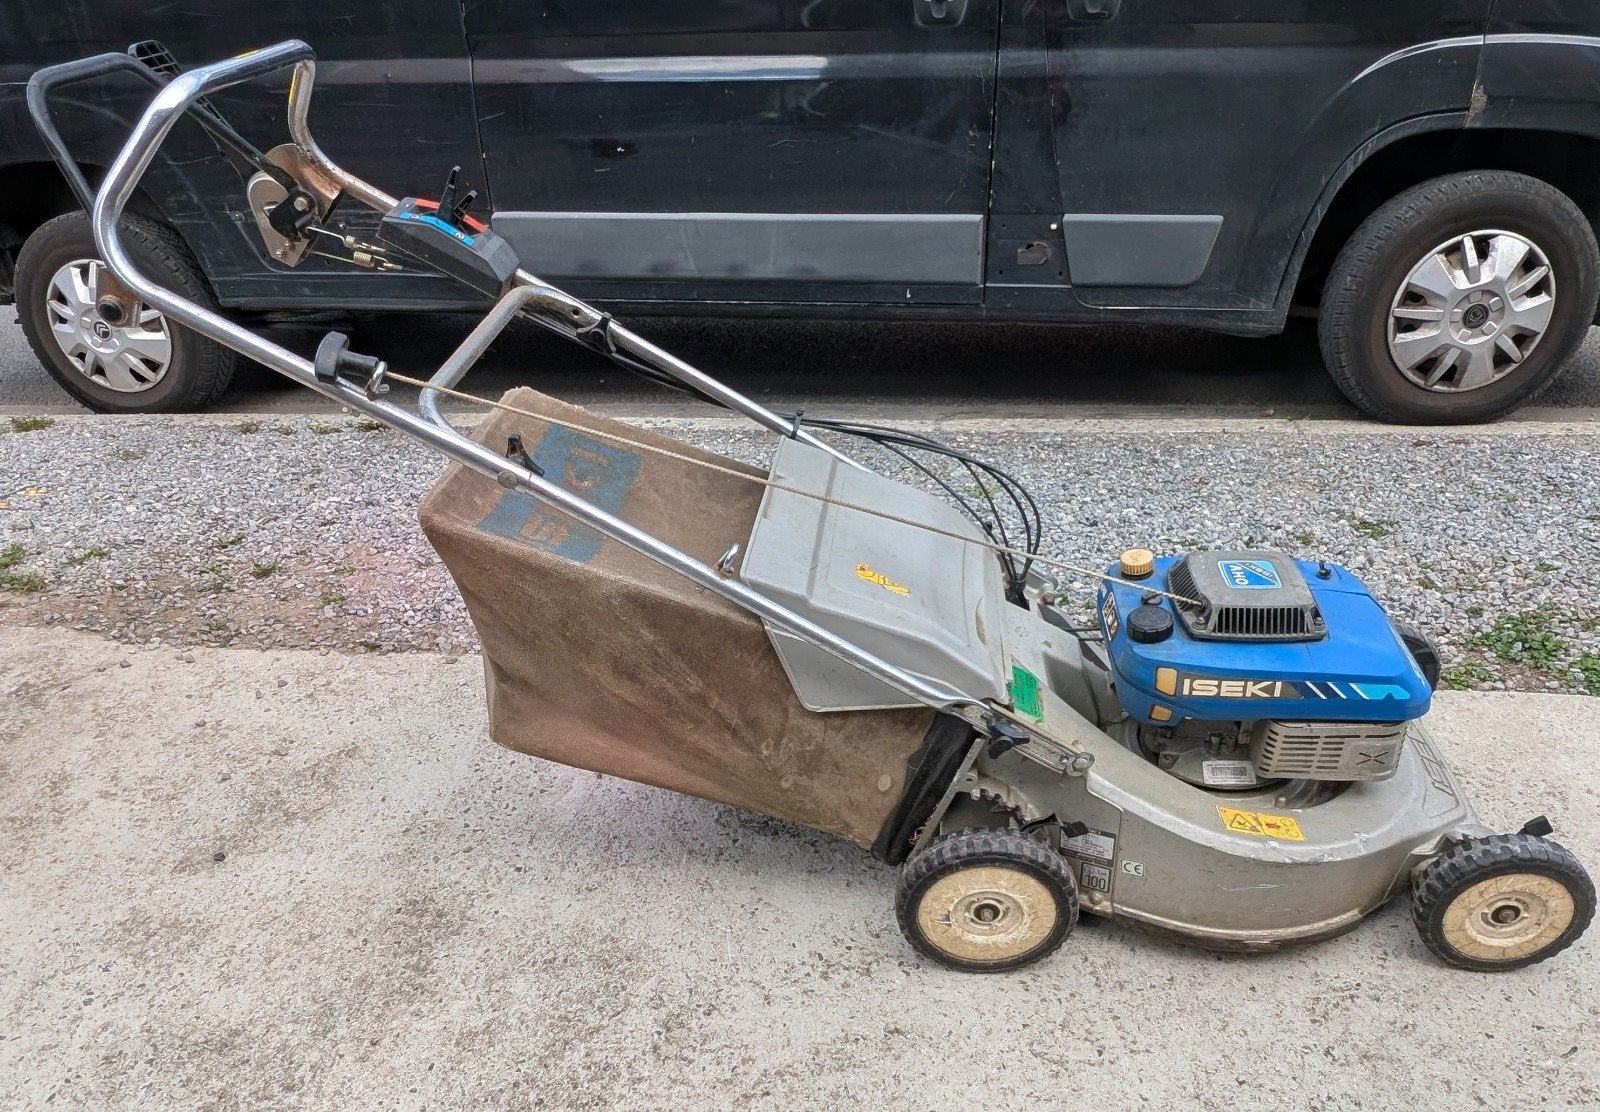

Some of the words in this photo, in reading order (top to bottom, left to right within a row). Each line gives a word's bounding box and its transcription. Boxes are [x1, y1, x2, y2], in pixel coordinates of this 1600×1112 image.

[1182, 678, 1282, 698] ISEKI
[1123, 862, 1142, 875] CE
[1084, 874, 1106, 890] 100
